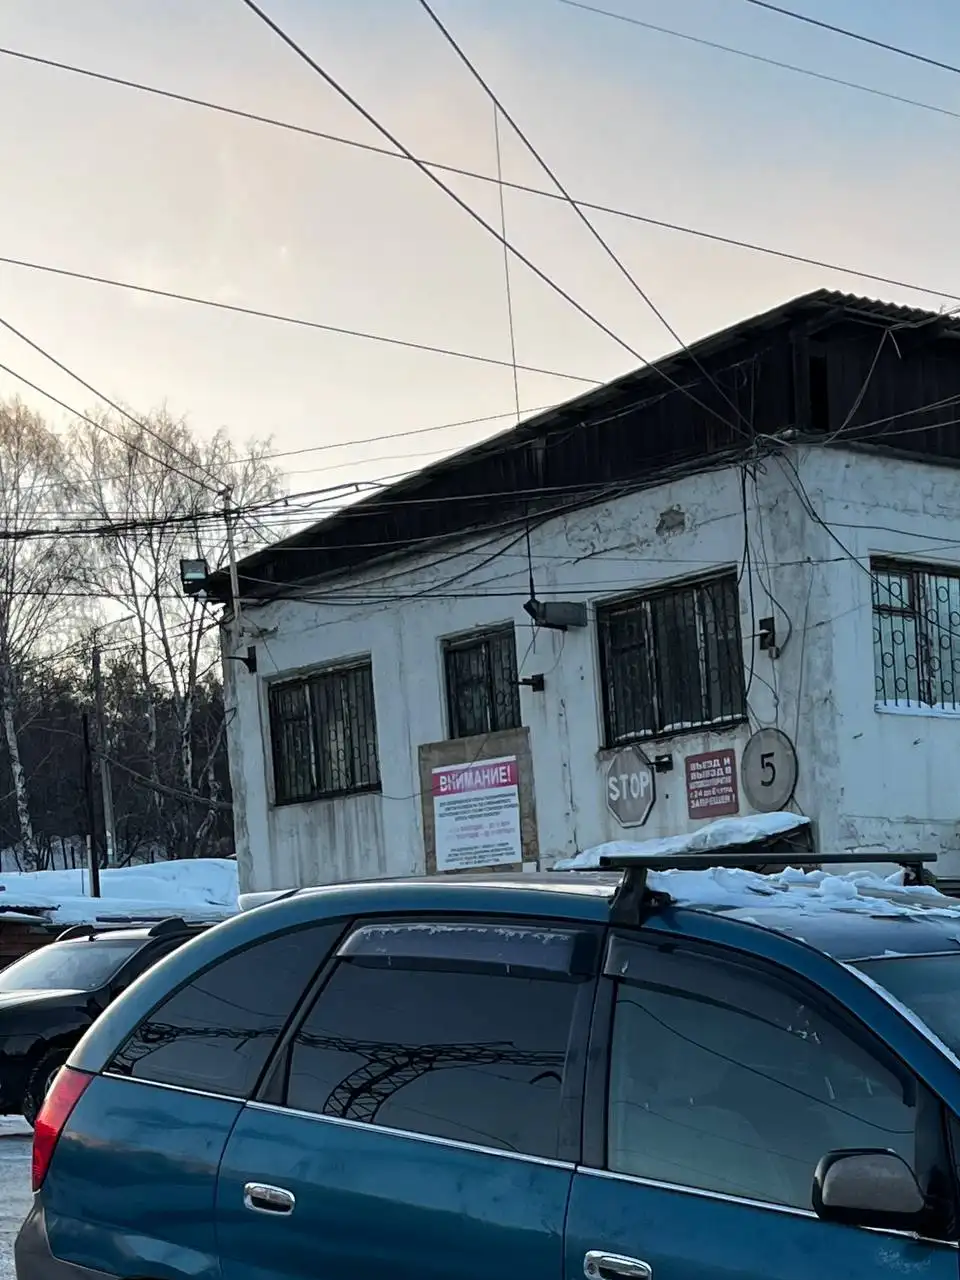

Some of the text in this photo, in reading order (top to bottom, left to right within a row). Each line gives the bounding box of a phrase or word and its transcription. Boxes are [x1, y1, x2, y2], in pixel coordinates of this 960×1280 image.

[440, 765, 511, 792] ВНИМАНИЕ!
[760, 752, 776, 787] 5
[608, 771, 650, 801] STOP
